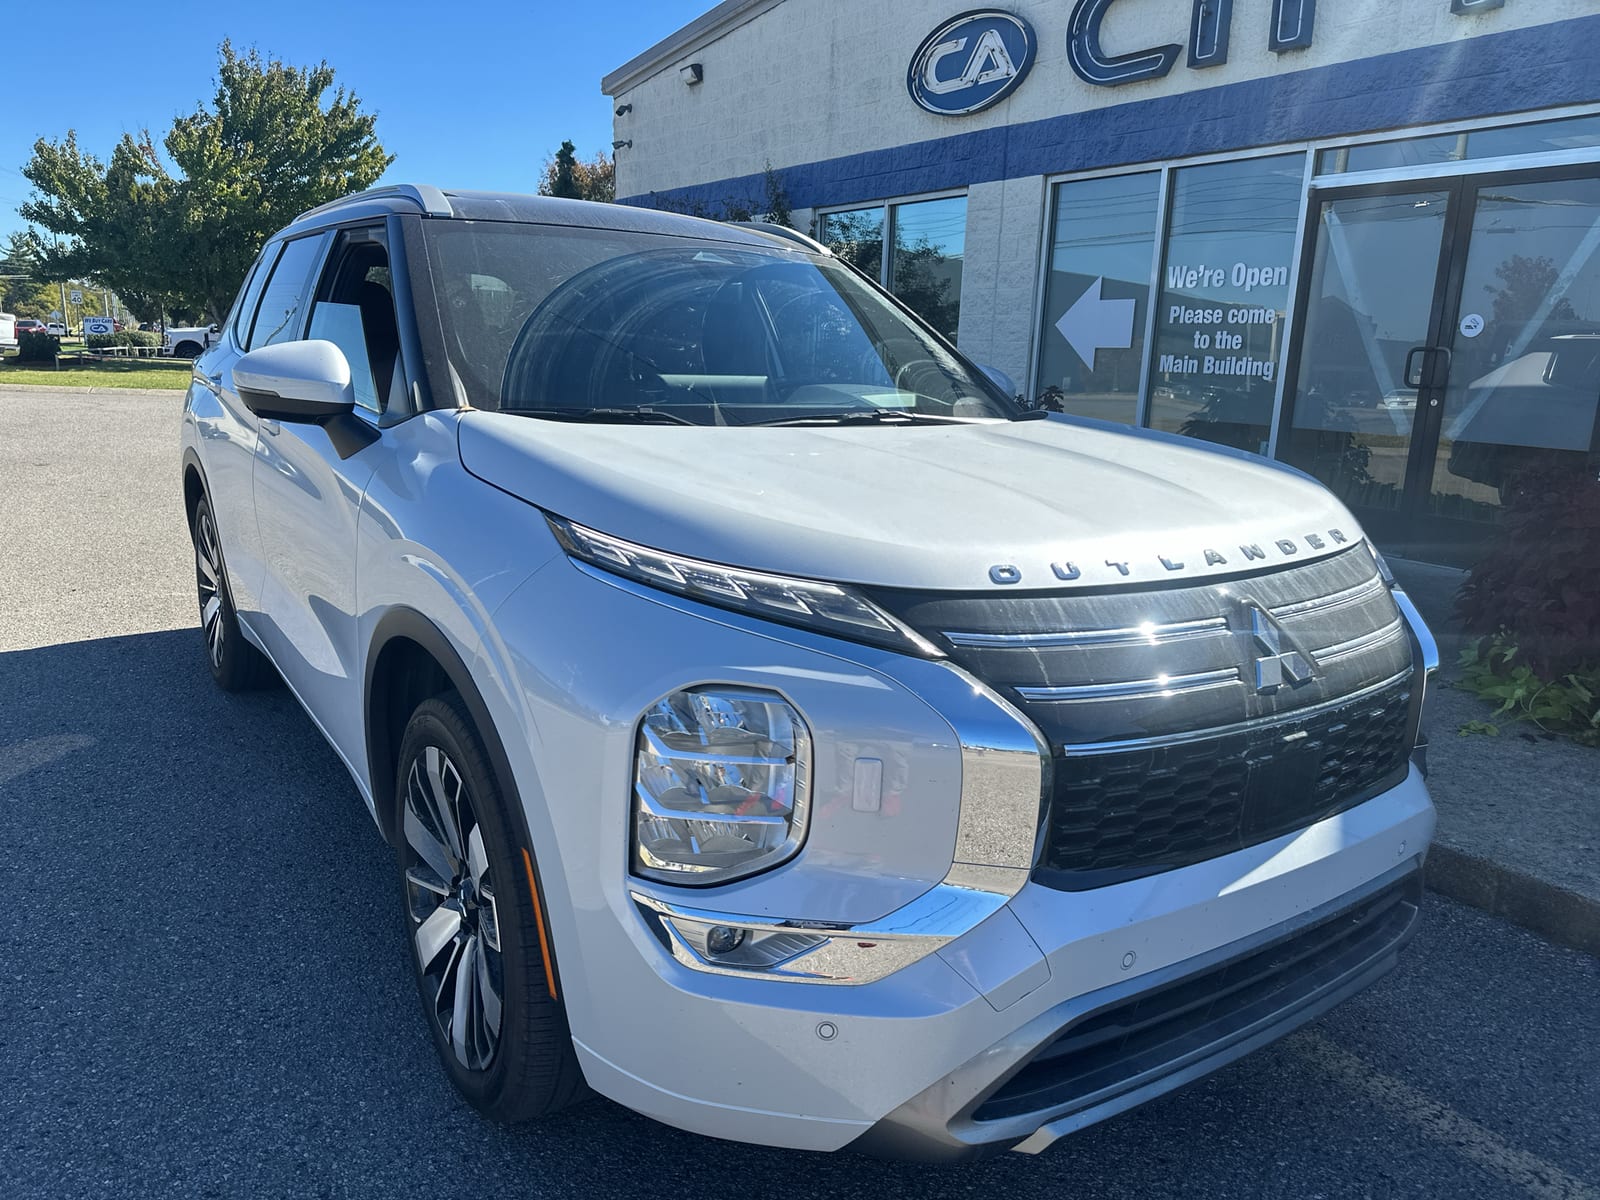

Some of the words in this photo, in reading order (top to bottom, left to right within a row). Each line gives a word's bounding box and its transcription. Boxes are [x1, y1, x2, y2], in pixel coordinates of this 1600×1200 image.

[1168, 264, 1225, 289] We're
[1231, 262, 1288, 292] Open
[1169, 305, 1223, 324] Please
[1227, 308, 1276, 324] come
[1193, 331, 1210, 349] to
[1215, 330, 1242, 350] the
[1159, 354, 1198, 374] Main
[1202, 355, 1275, 382] Building
[988, 527, 1348, 585] OUTLANDER
